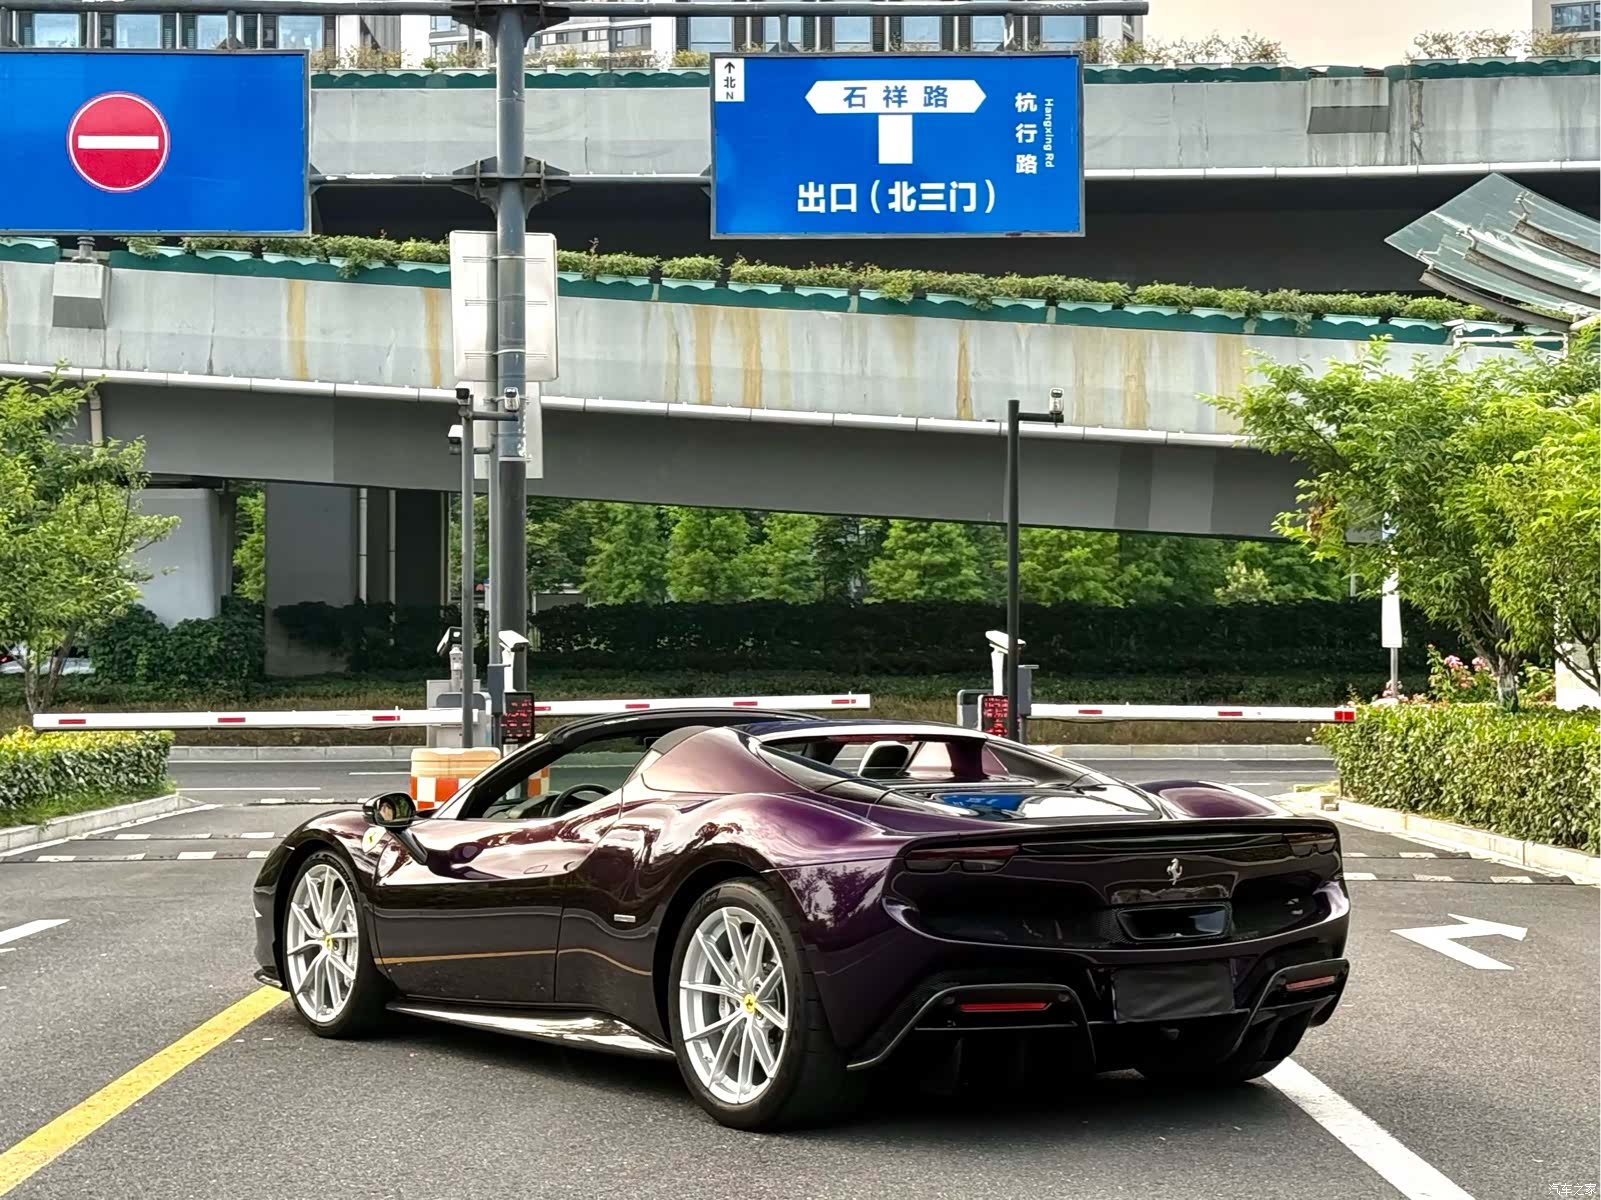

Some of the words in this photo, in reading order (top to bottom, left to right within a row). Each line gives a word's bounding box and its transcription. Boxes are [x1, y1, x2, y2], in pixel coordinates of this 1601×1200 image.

[723, 76, 736, 88] 北
[726, 91, 734, 100] N
[843, 85, 949, 108] 石祥路
[1015, 92, 1038, 175] 杭行路
[1043, 98, 1055, 151] Hangxing
[1044, 152, 1055, 168] Rd
